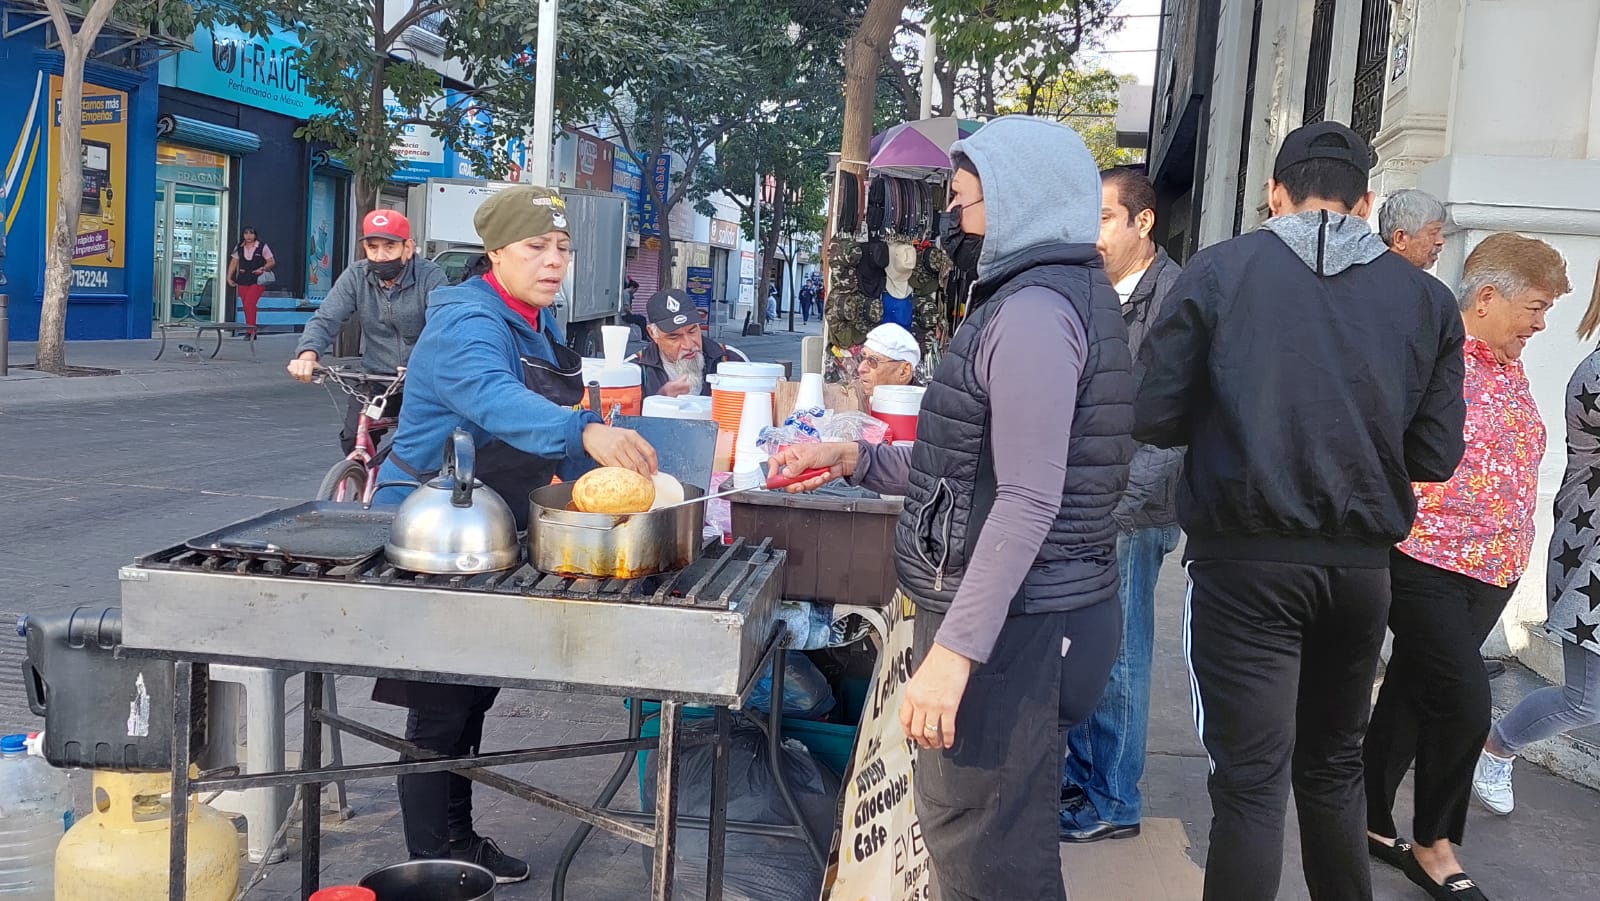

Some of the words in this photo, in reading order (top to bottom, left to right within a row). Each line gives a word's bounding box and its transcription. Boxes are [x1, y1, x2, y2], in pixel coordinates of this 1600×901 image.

[240, 40, 310, 96] FRAICH
[105, 97, 120, 109] más
[228, 78, 272, 101] Perfumando
[273, 92, 279, 101] a
[280, 93, 304, 108] México
[82, 110, 113, 124] Empeños
[854, 772, 908, 829] Chocolate
